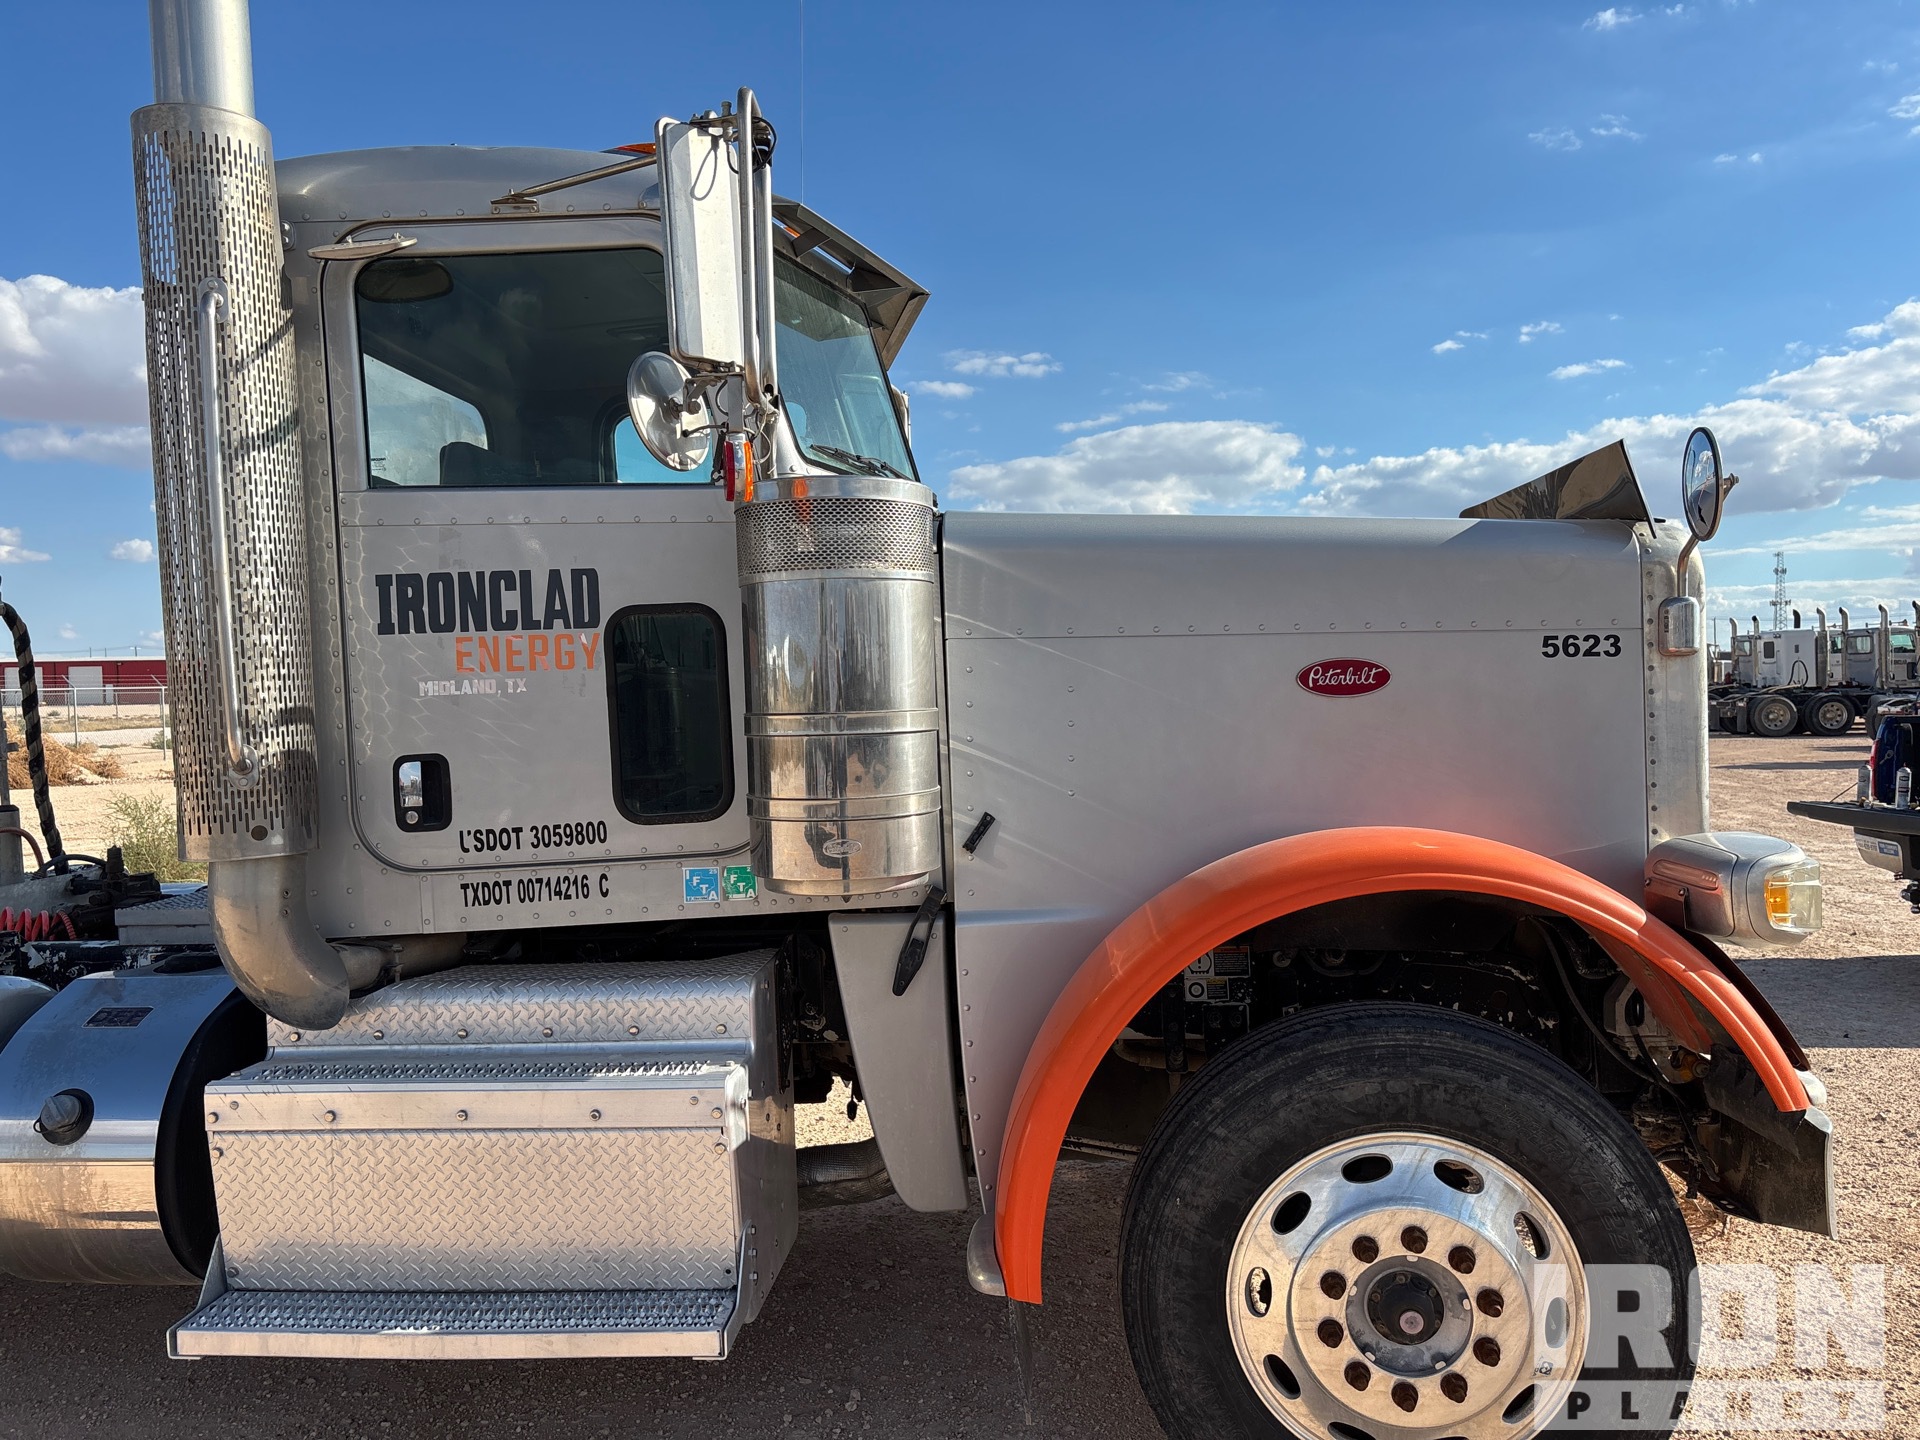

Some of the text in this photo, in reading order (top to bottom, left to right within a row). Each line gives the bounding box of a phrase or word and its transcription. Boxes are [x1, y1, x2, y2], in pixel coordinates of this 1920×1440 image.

[375, 568, 600, 635] IRONCLAD
[455, 632, 600, 673] ENERGY
[1541, 634, 1622, 658] 5623
[419, 678, 527, 697] MIDLAND, TX
[1308, 666, 1383, 688] Peterbilt
[530, 820, 607, 850] 3059800
[460, 873, 609, 907] TXDOT 00714216 C
